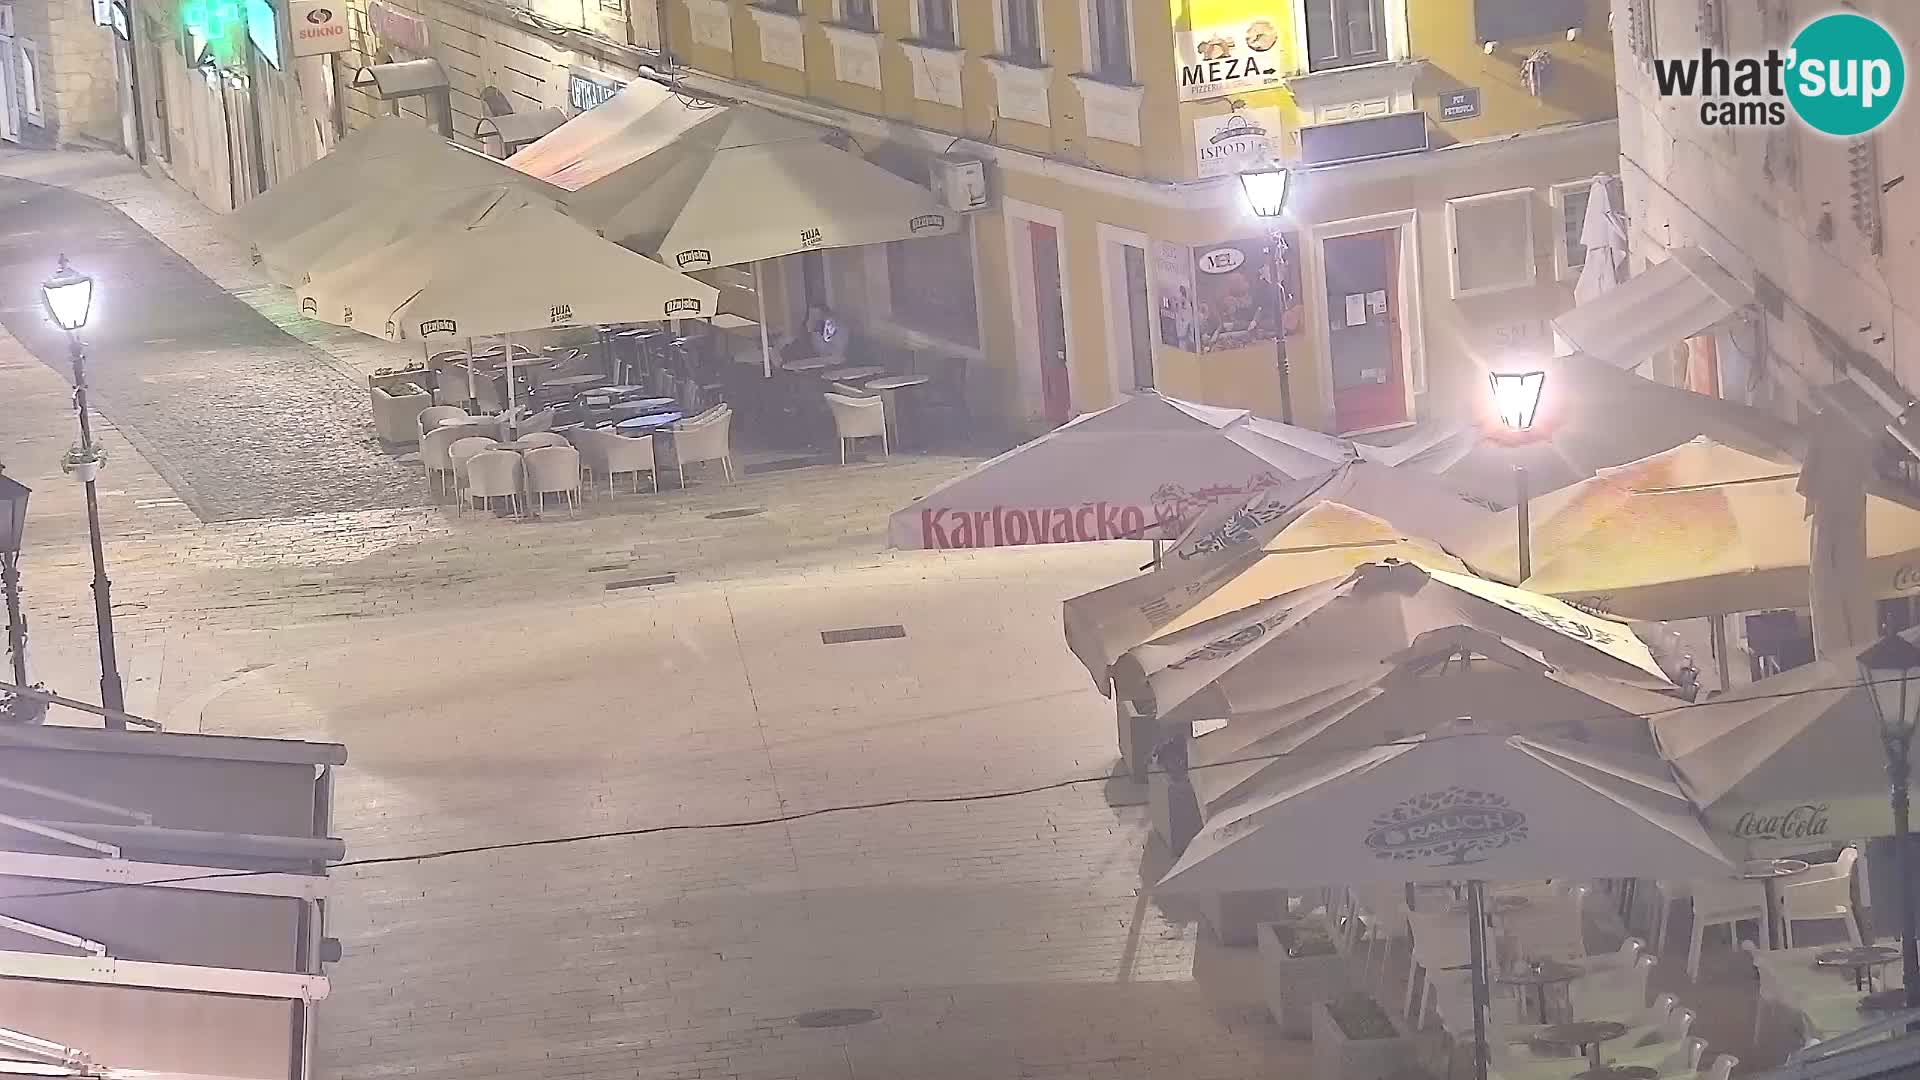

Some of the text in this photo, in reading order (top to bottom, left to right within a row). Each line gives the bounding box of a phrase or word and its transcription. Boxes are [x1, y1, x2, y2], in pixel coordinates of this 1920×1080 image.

[299, 25, 344, 39] SUKNO
[1182, 57, 1261, 86] MEZA
[921, 501, 1146, 550] Karlovačko
